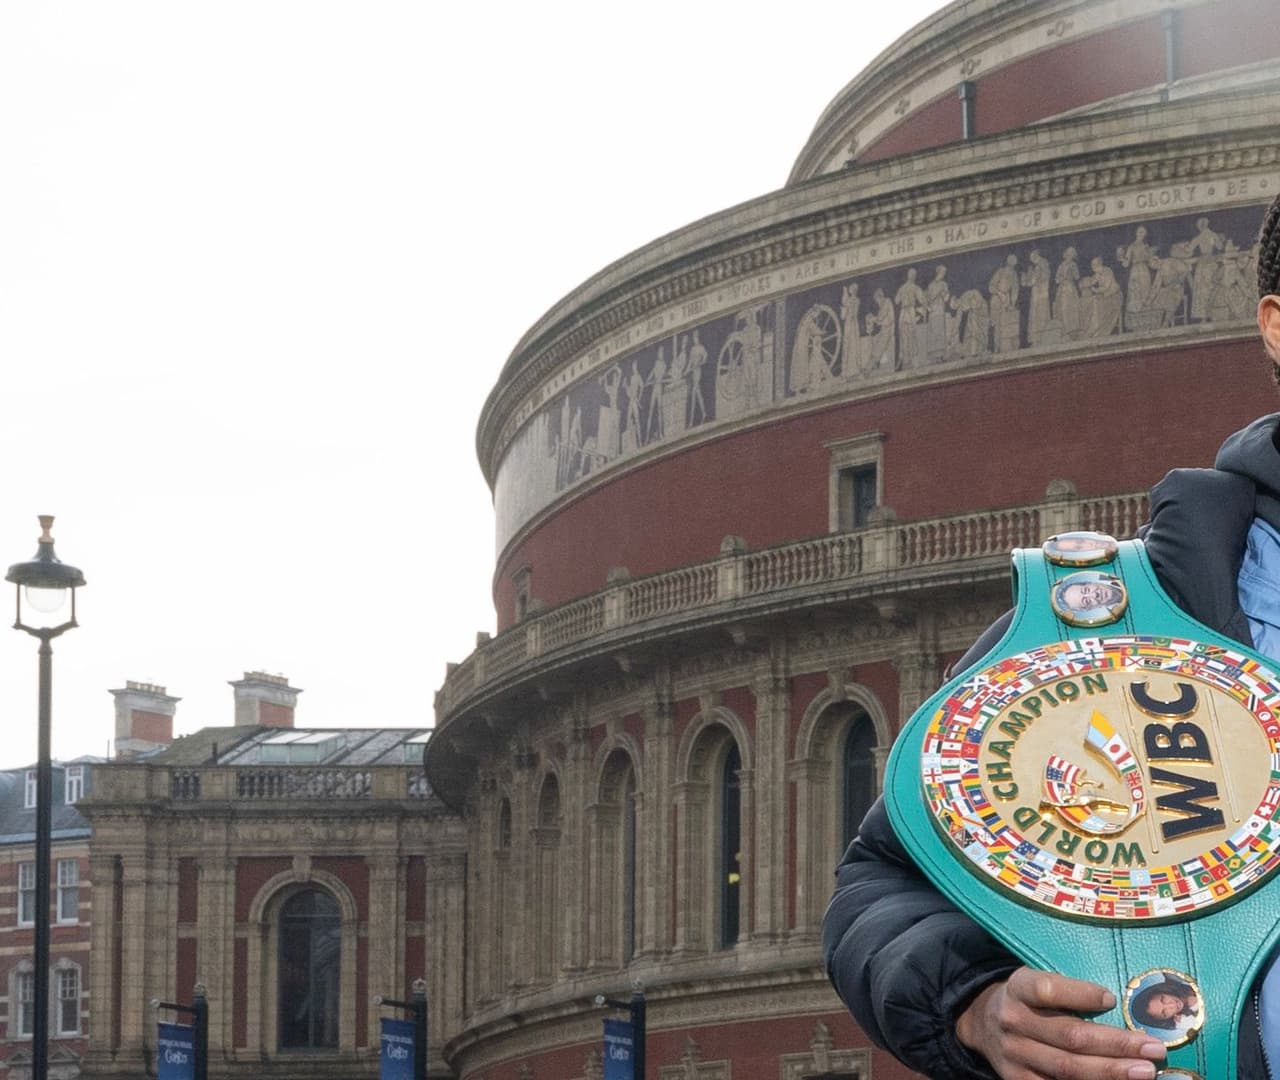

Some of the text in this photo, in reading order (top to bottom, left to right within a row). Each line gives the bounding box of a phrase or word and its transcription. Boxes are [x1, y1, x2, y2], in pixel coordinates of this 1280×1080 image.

[795, 261, 821, 281] ARE
[887, 237, 915, 256] THE
[944, 222, 989, 244] HAND
[1135, 186, 1197, 209] GLORY
[1226, 178, 1249, 197] BE
[985, 671, 1148, 868] WORLD CHAMPION
[1131, 681, 1227, 844] WBC
